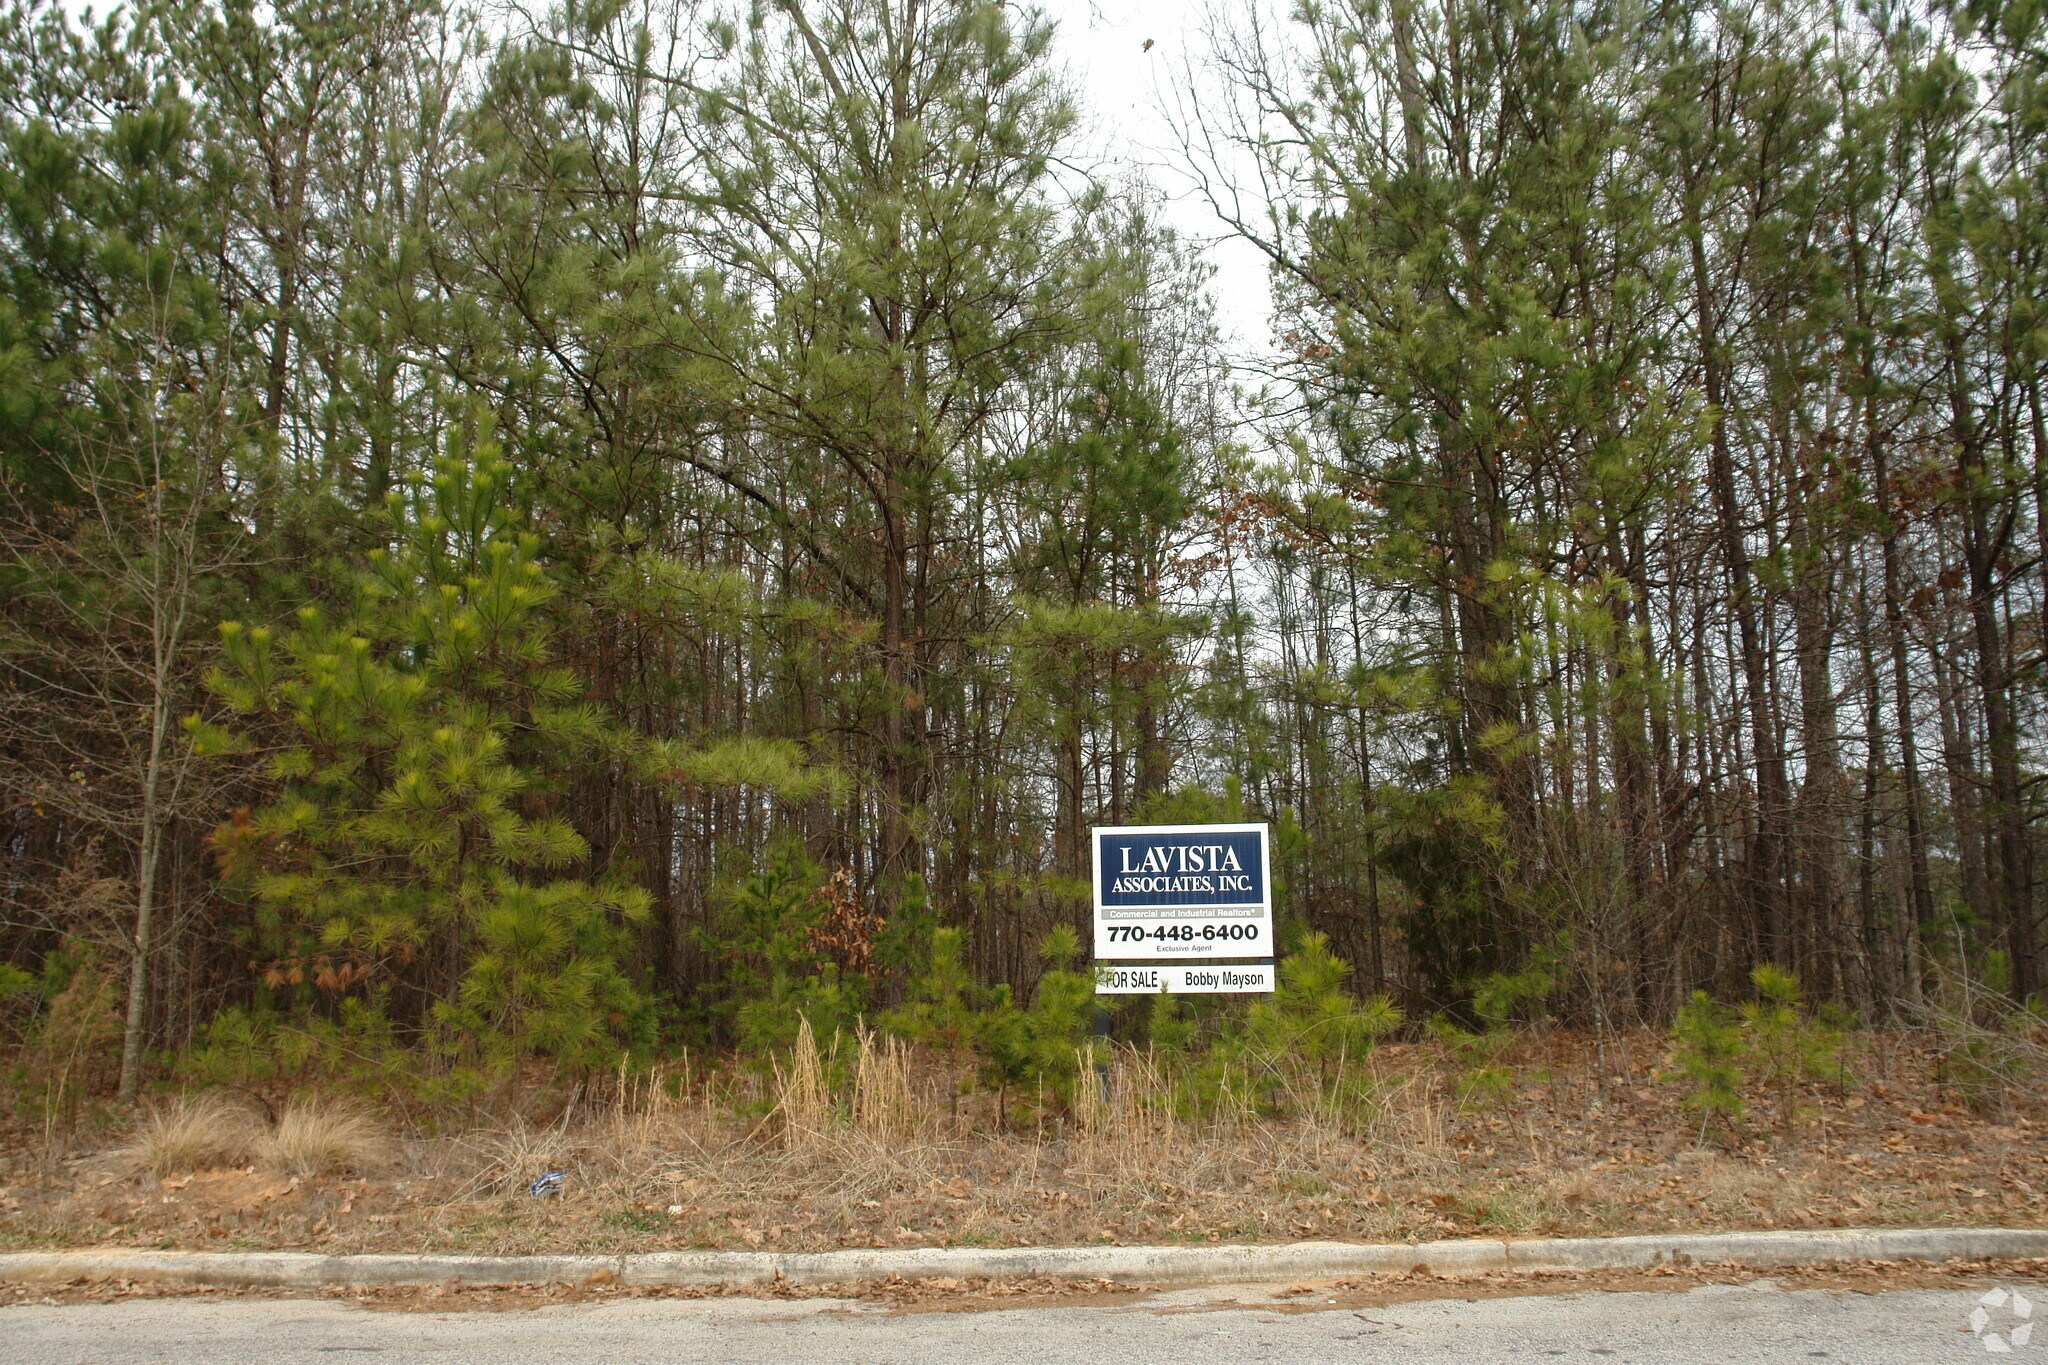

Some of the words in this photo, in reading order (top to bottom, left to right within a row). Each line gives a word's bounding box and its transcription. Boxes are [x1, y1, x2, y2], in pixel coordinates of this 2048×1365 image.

[1120, 845, 1242, 873] LAVISTA
[1112, 876, 1214, 894] ASSOCIATES,
[1219, 875, 1253, 891] INC.
[1110, 910, 1158, 918] Commercial
[1160, 910, 1175, 918] and
[1178, 909, 1215, 917] Industrial
[1107, 924, 1258, 942] 770-448-6400
[1191, 945, 1212, 953] Agent
[1131, 971, 1158, 988] SALE
[1185, 971, 1219, 989] Bobby
[1223, 971, 1264, 989] Mayson
